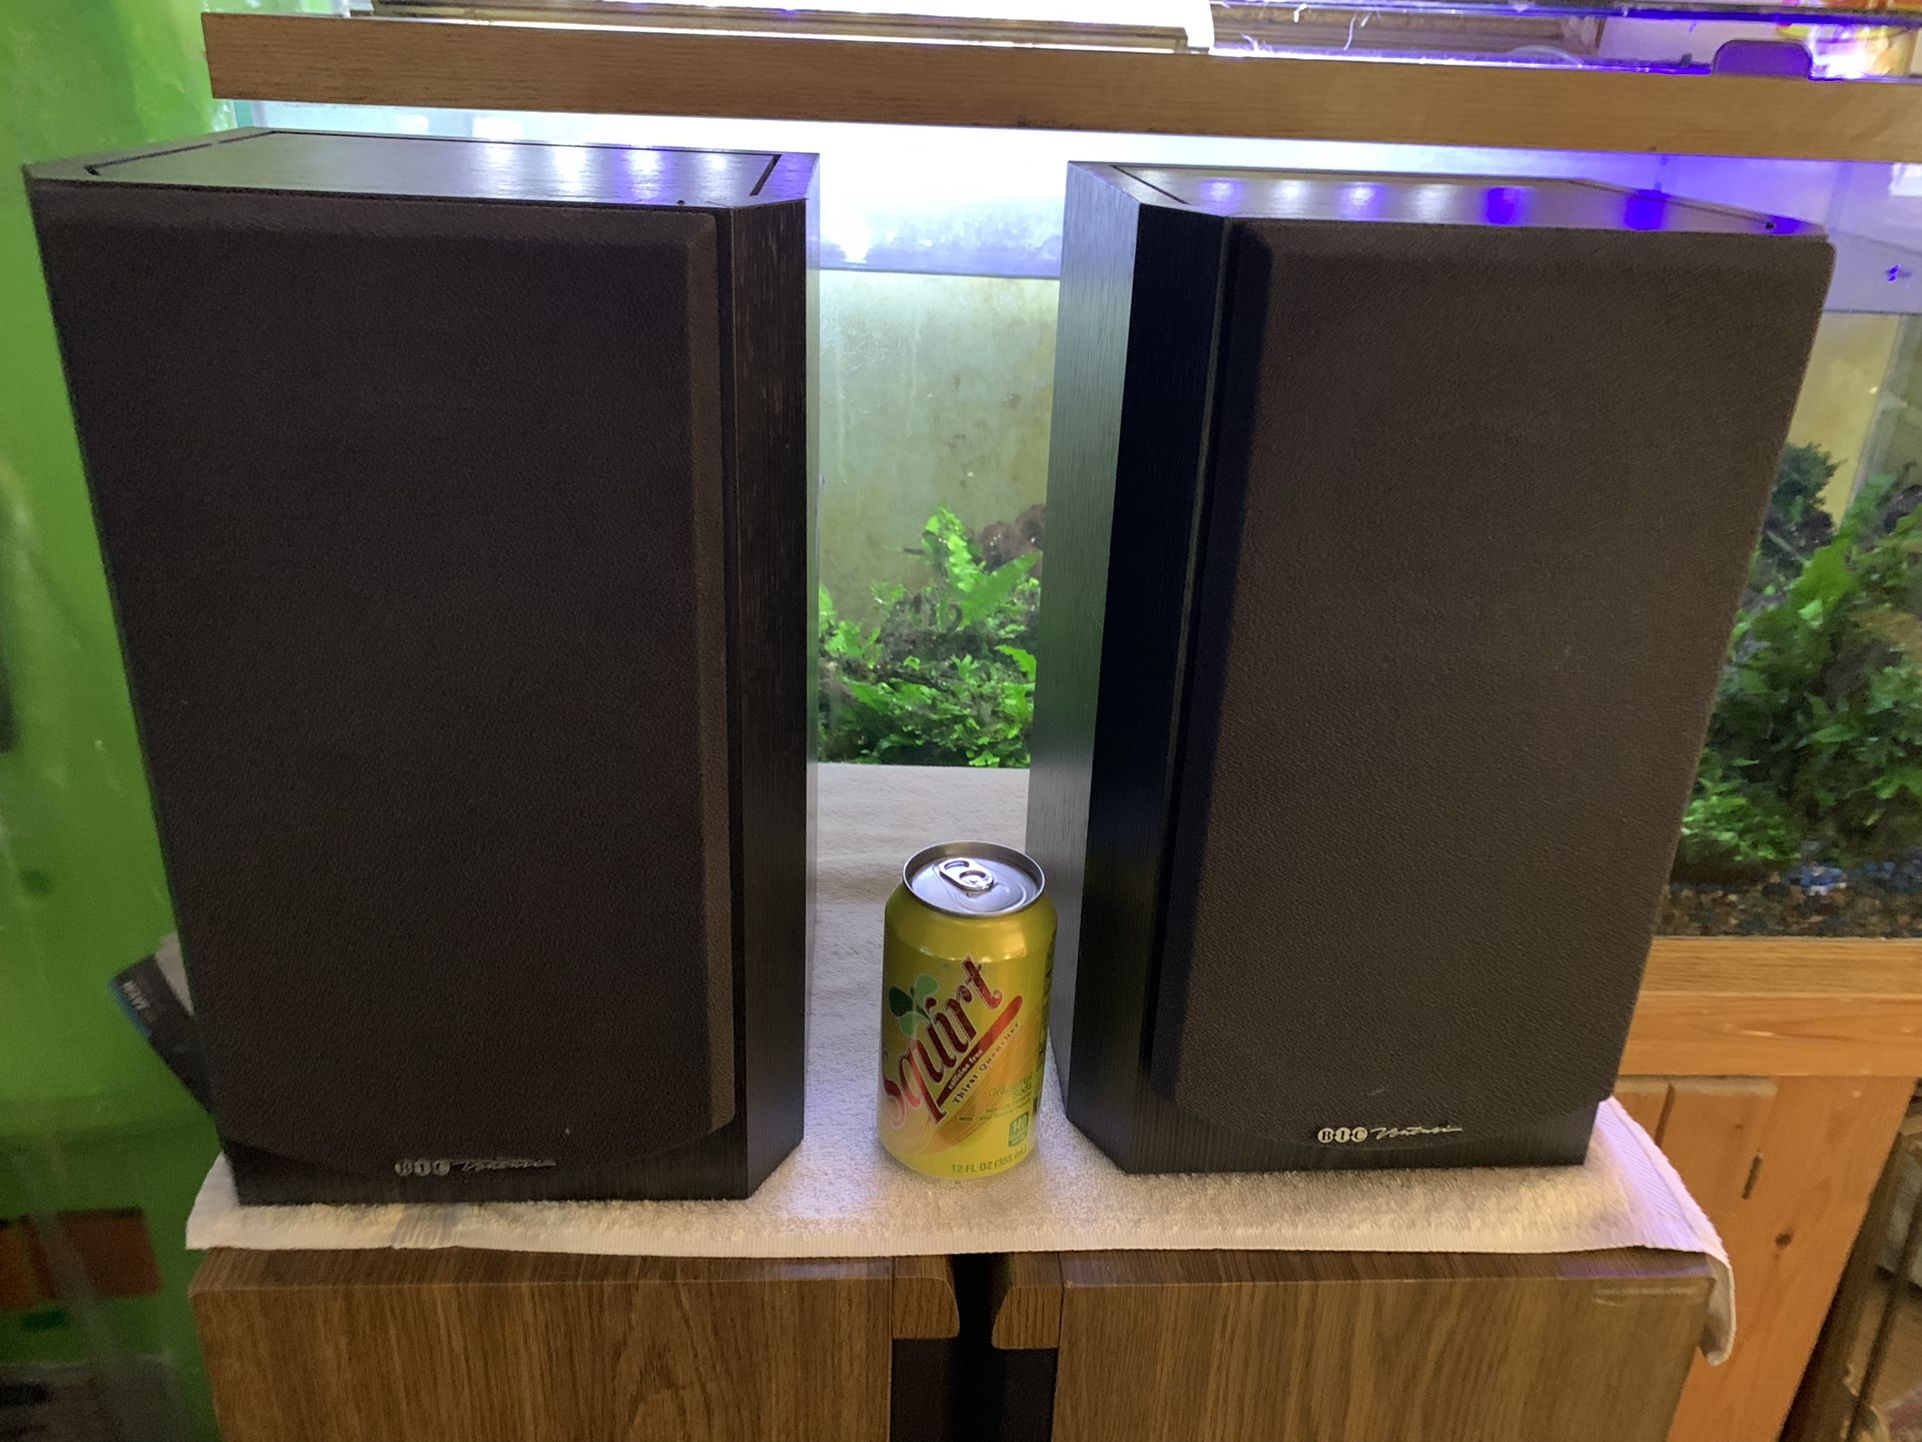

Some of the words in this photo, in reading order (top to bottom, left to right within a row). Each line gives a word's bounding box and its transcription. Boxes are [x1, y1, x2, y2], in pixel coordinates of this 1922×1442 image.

[952, 1074, 979, 1105] Thirst
[1317, 1126, 1369, 1143] BIC
[952, 1164, 963, 1173] 12
[966, 1164, 977, 1173] FL
[980, 1160, 992, 1171] OZ
